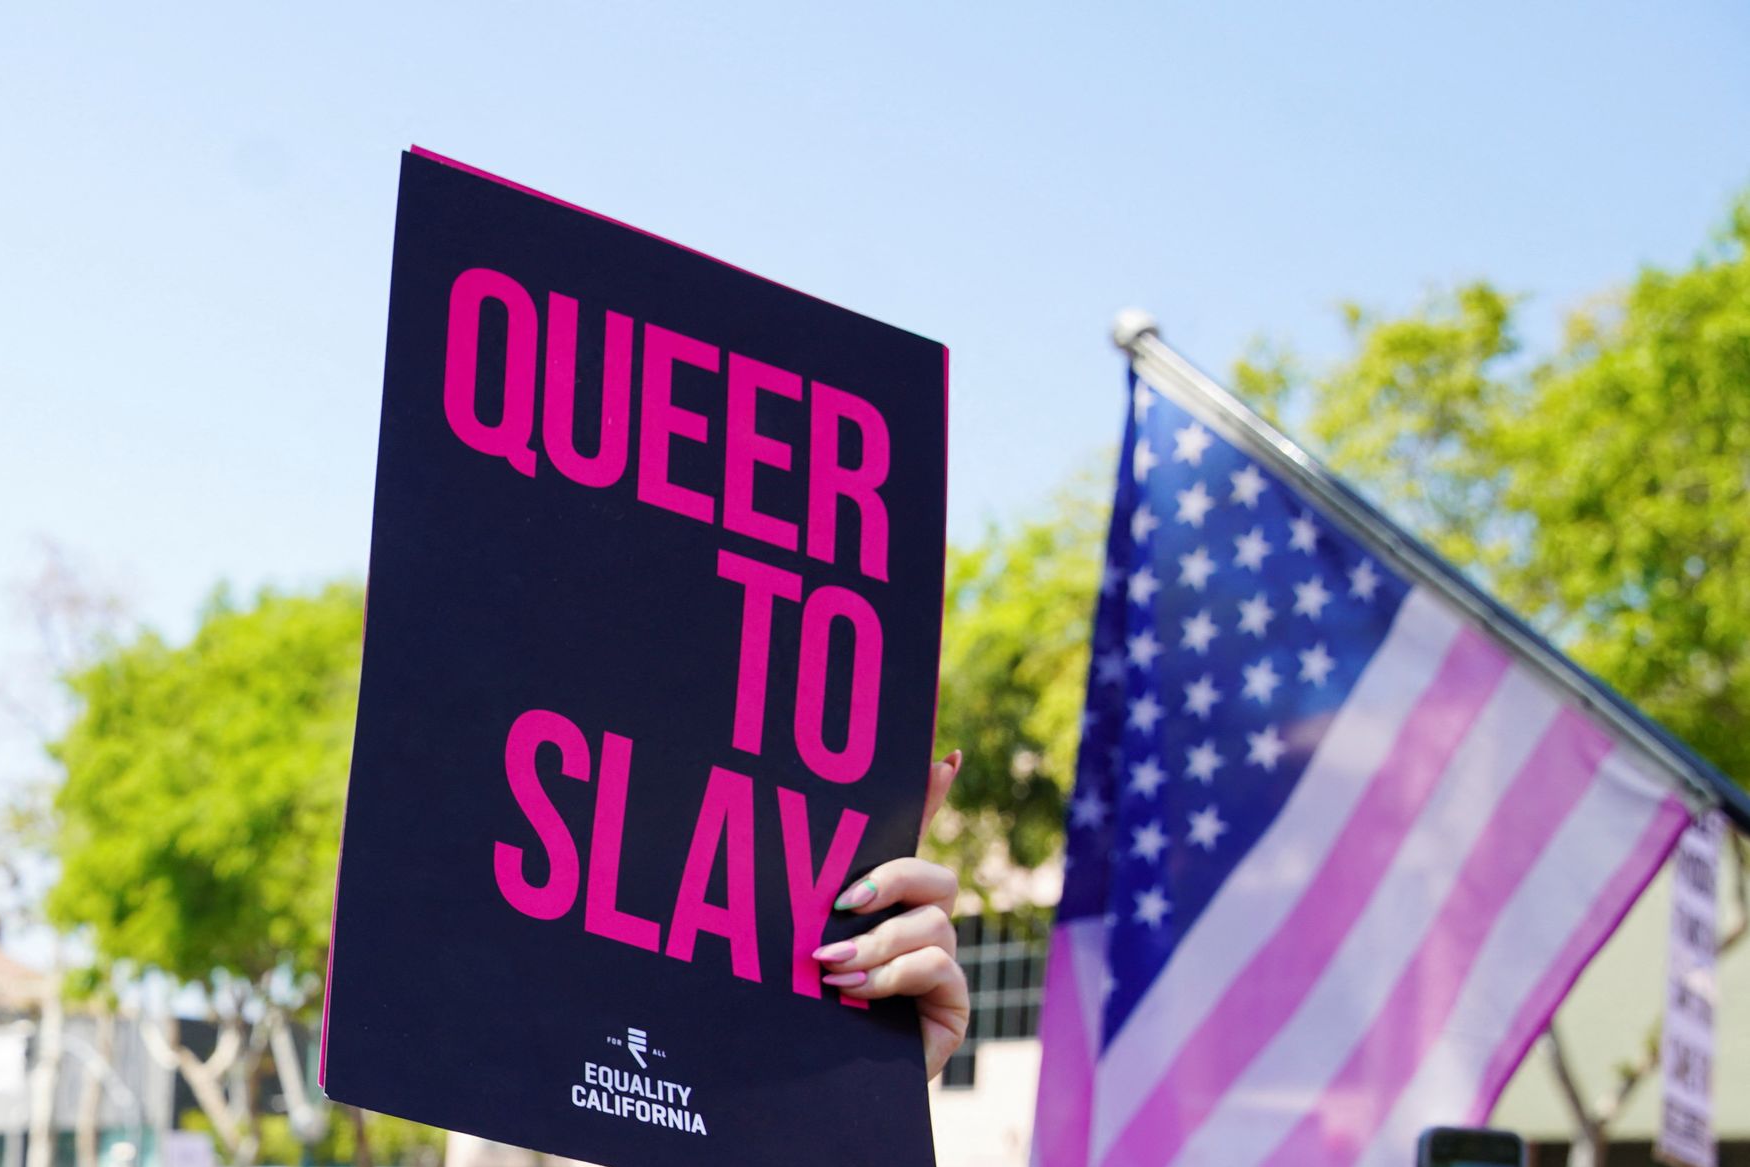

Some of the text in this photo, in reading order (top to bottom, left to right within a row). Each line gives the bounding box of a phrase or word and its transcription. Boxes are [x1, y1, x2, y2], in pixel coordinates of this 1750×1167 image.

[444, 268, 890, 582] QUEER
[717, 549, 884, 783] TO
[606, 1036, 666, 1058] FOR ALL
[571, 1084, 708, 1136] CALIFORNIA
[584, 1061, 692, 1107] EQUALITY
